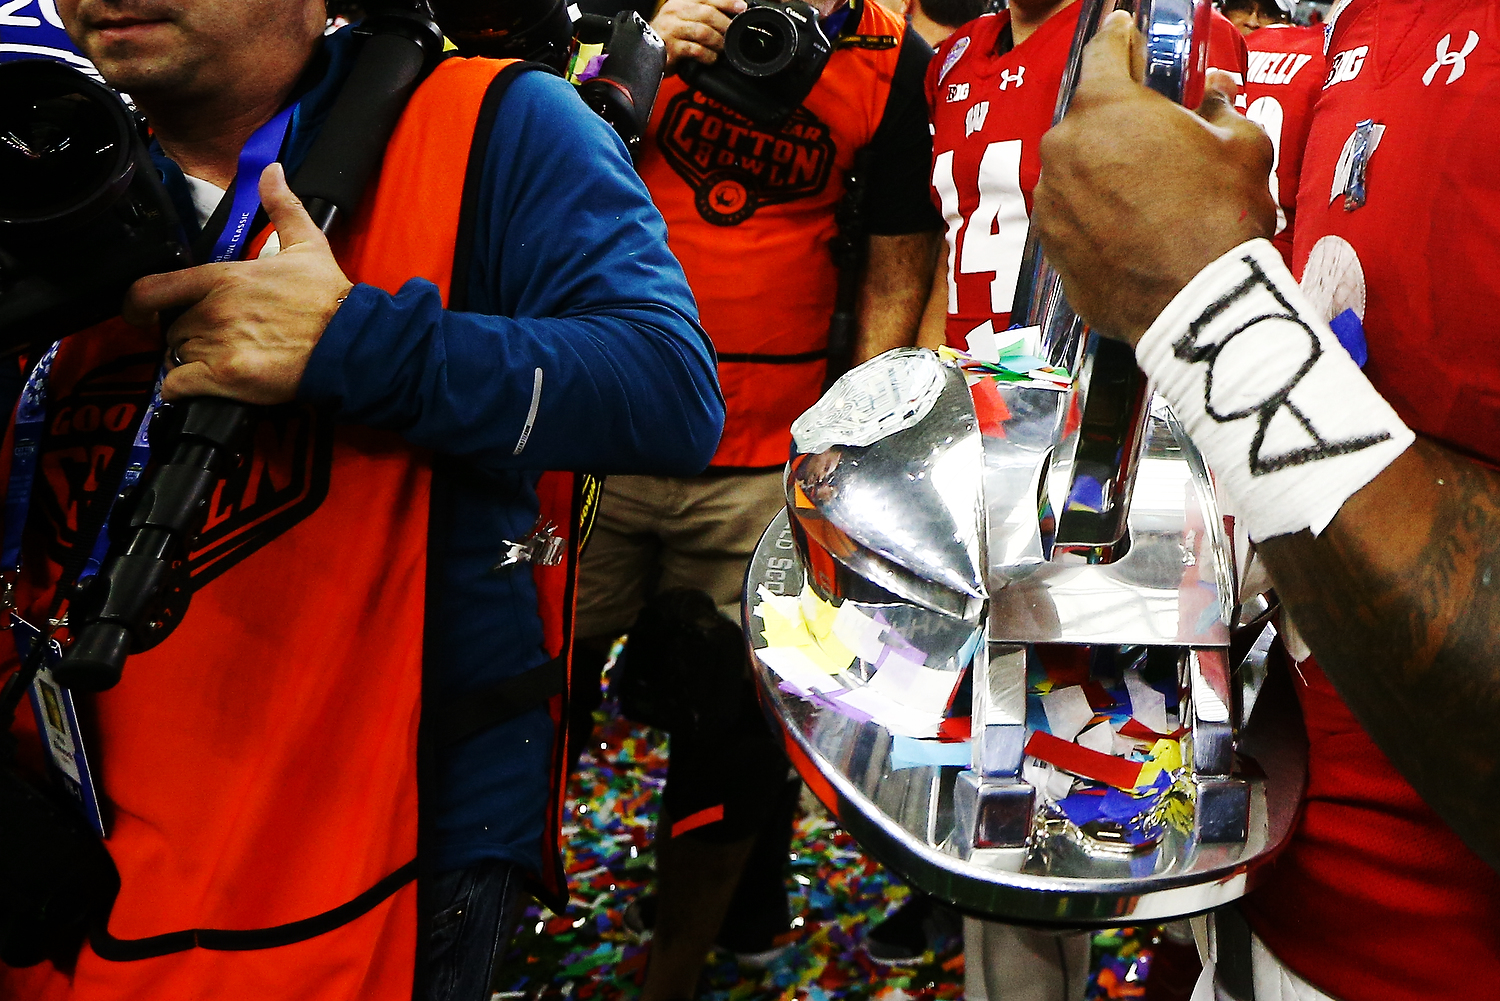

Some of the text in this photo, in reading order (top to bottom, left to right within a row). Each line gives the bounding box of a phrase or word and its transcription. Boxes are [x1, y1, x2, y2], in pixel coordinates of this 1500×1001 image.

[964, 100, 990, 140] W
[672, 107, 821, 185] COTTON
[693, 139, 784, 187] BOWL
[231, 211, 251, 243] CLASSIC
[931, 139, 1031, 315] 14
